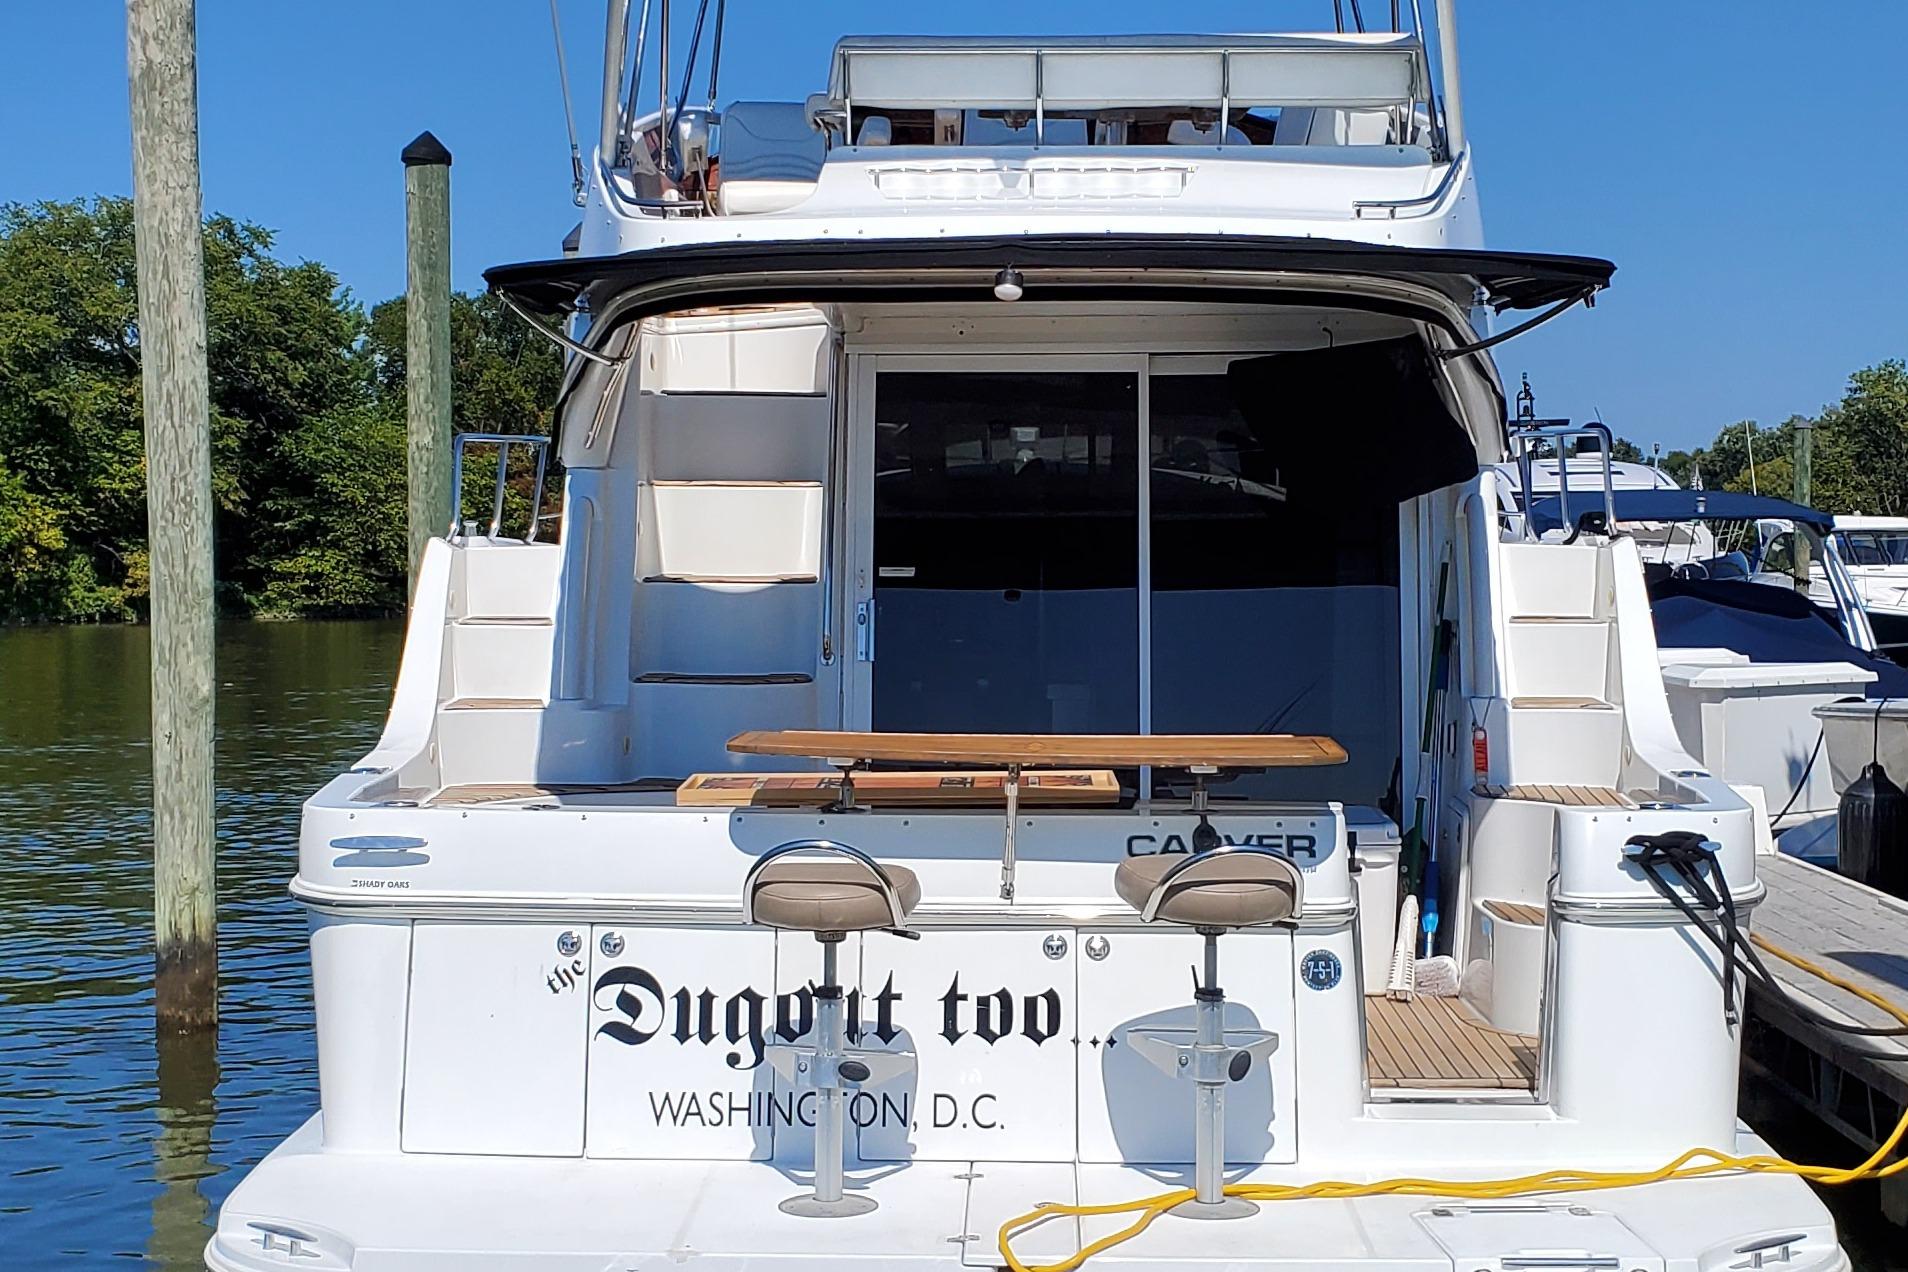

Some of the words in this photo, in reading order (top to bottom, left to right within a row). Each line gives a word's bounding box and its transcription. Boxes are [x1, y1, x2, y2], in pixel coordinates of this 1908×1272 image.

[1127, 834, 1316, 858] CAVER
[359, 880, 385, 889] SHADY
[546, 958, 587, 995] the
[648, 1091, 918, 1133] WASHINGON,
[932, 1093, 1005, 1130] D.C.
